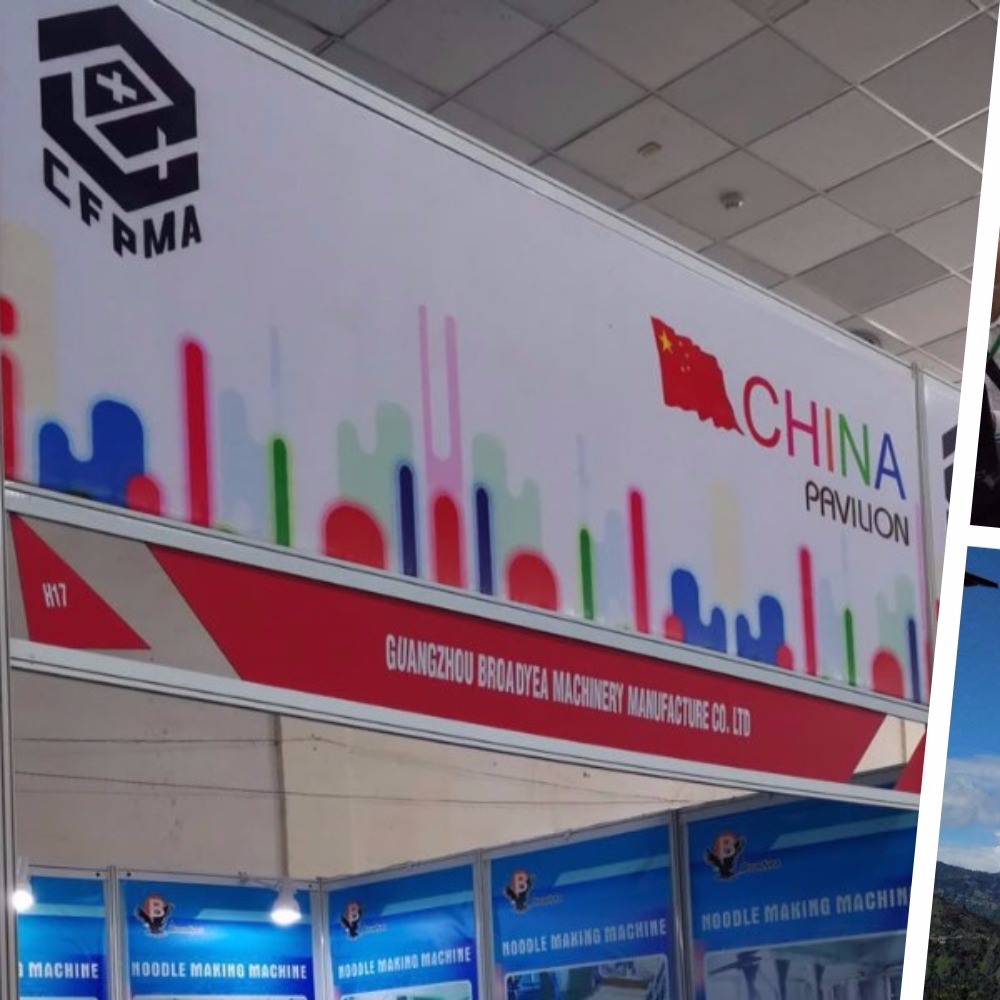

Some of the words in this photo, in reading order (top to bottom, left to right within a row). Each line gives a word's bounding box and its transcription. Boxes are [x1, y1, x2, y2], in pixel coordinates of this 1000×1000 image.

[743, 376, 906, 500] CHINA
[805, 480, 909, 546] PAVILION
[42, 582, 68, 608] H17
[385, 633, 474, 686] GUANGZHOU
[478, 653, 549, 700] BROADYEA
[552, 669, 625, 714] MACHINERY
[628, 683, 710, 731] MANUFACTURE
[712, 703, 731, 733] CO.
[733, 707, 751, 738] LTD
[702, 907, 760, 930] NOODLE
[764, 897, 831, 922] MAKING
[836, 885, 909, 914] MACHIN
[503, 936, 548, 956] NOODLE
[551, 929, 601, 950] MAKING
[604, 918, 667, 943] MACHINE
[28, 960, 99, 979] MACHINE
[131, 961, 186, 978] NOODLE
[190, 962, 243, 978] MAKING
[248, 962, 307, 980] MACHINE
[338, 959, 376, 979] NOODLE
[377, 954, 419, 973] MAKING
[421, 946, 471, 969] MACHINE
